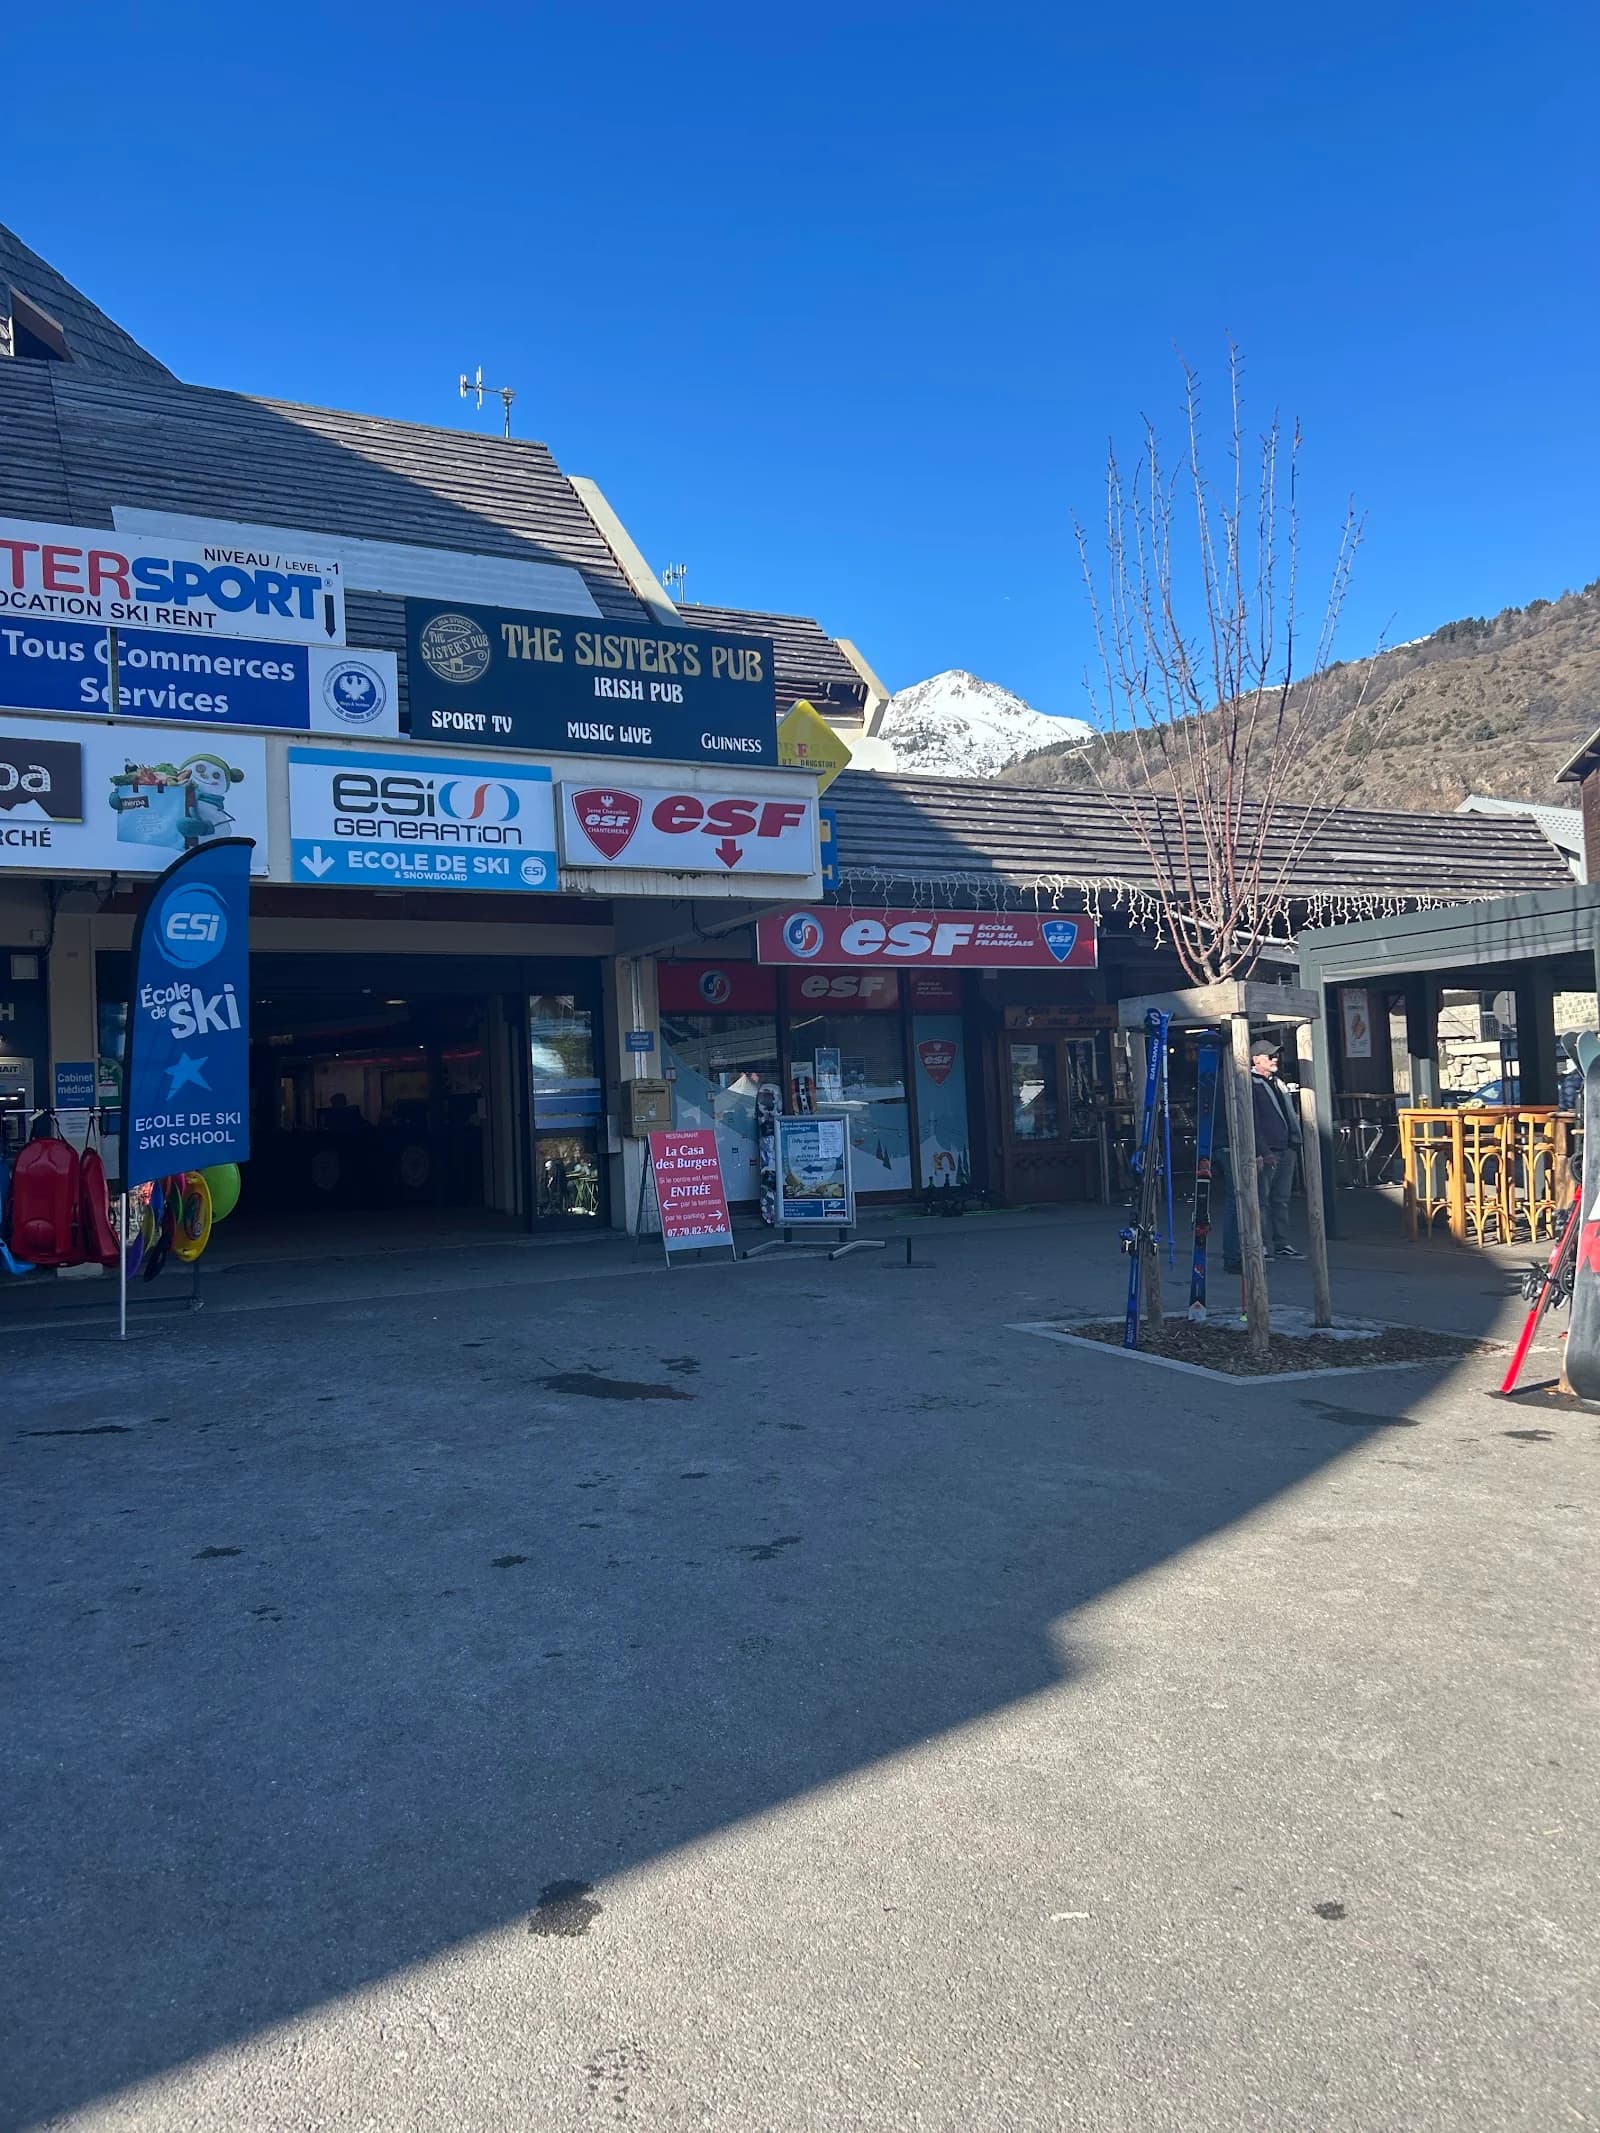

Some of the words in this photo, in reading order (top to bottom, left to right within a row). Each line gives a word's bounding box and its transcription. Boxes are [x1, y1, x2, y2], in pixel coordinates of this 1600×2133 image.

[204, 548, 270, 567] NIVEAU
[286, 560, 322, 573] LEVEL
[326, 562, 339, 575] -1
[110, 603, 149, 622] SKI
[156, 608, 217, 629] RENT
[2, 629, 85, 662] Tous
[428, 631, 446, 644] THE
[470, 633, 489, 649] PUB
[501, 623, 564, 664] THE
[575, 632, 701, 677] SISTER'S
[711, 646, 764, 682] PUB
[594, 676, 645, 701] IRISH
[650, 682, 684, 704] PUB
[431, 710, 486, 731] SPORT
[491, 714, 513, 734] TV
[567, 721, 615, 742] MUSIC
[619, 726, 652, 745] LIVE
[700, 732, 762, 753] GUINNESS
[348, 850, 428, 873] ECOLE
[435, 855, 468, 873] DE
[473, 855, 510, 875] SKI
[524, 865, 544, 876] ESI
[394, 871, 401, 879] &
[403, 871, 468, 882] SNOWBOARD
[978, 923, 1015, 931] ÉCOLE
[975, 939, 1035, 948] FRANÇAIS
[140, 981, 193, 1009] École
[150, 1005, 167, 1020] de
[168, 983, 242, 1040] ski
[57, 1072, 93, 1084] Cabinet
[57, 1083, 94, 1095] médical
[135, 1113, 185, 1132] ECOLE
[189, 1112, 212, 1126] DE
[215, 1111, 242, 1125] SKI
[139, 1133, 165, 1150] SKI
[168, 1130, 236, 1147] SCHOOL
[665, 1146, 677, 1157] La
[679, 1144, 705, 1157] Casa
[656, 1158, 675, 1170] des
[677, 1157, 718, 1171] Burgers
[670, 1182, 711, 1198] ENTRÉE
[667, 1223, 726, 1237] 07.70.82.76.46
